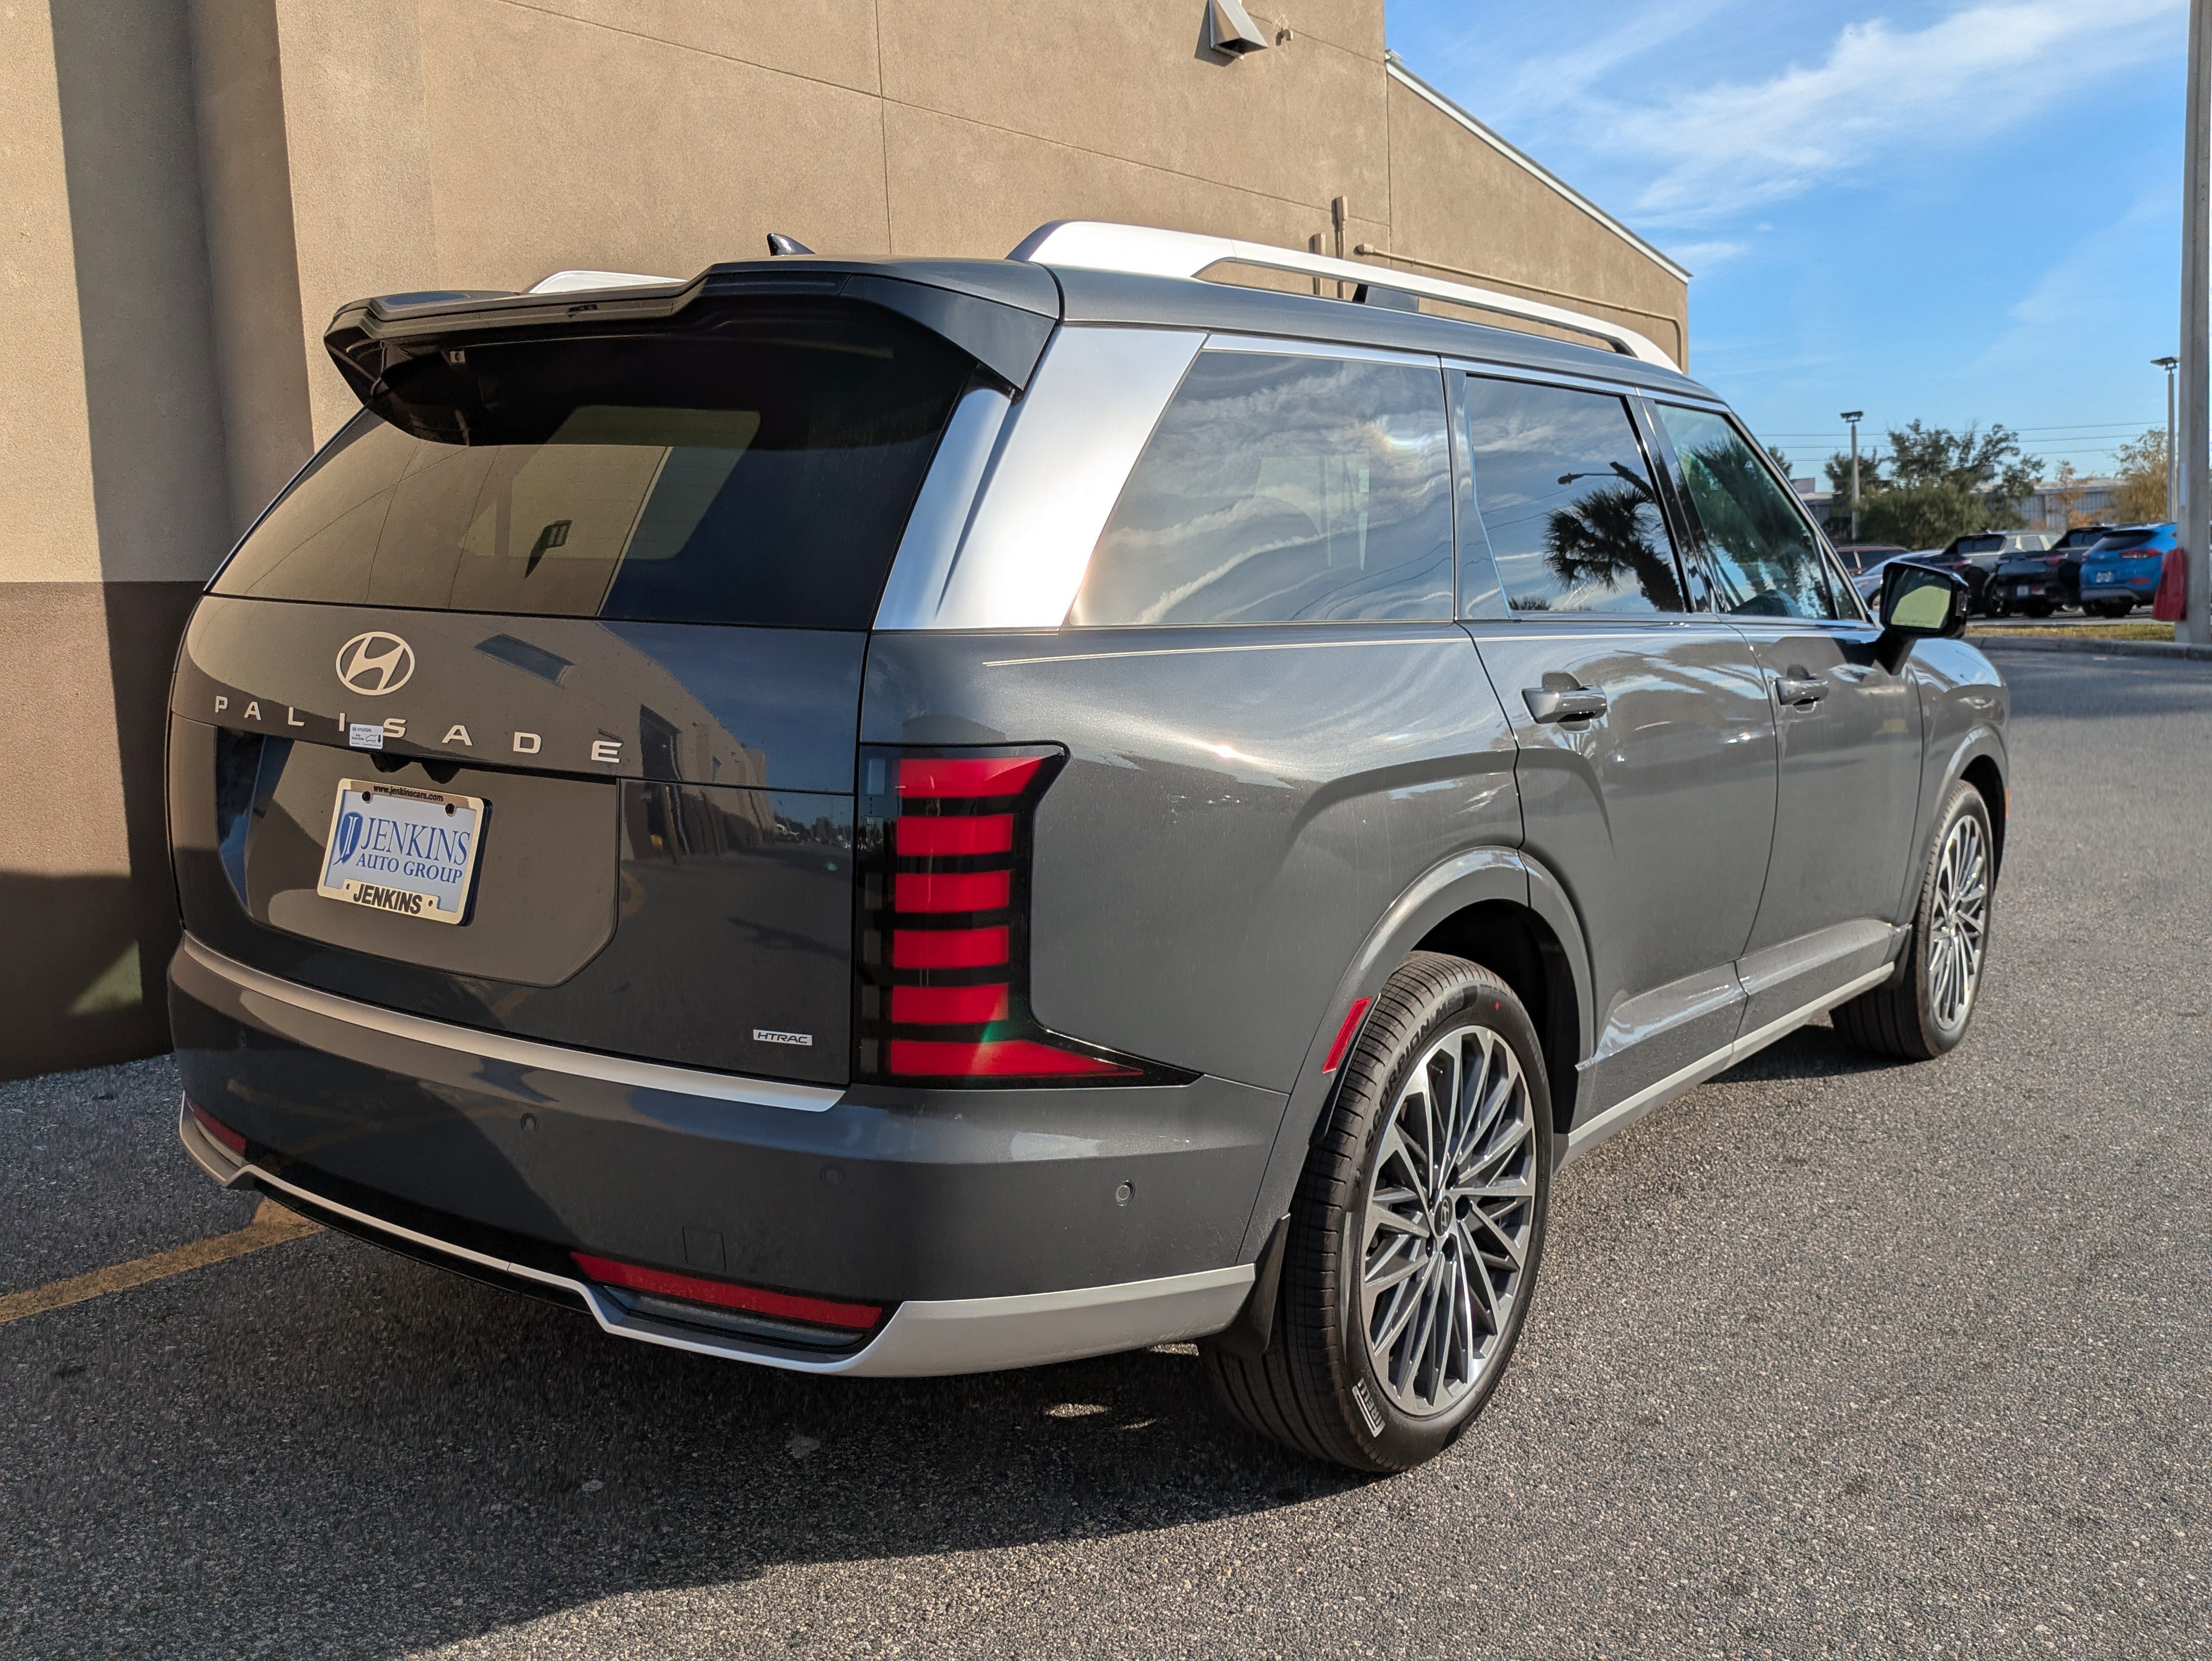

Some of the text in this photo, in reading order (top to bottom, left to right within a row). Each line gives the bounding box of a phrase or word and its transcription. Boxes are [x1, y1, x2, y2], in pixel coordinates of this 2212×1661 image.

[214, 696, 623, 764] PALISADE
[374, 786, 444, 802] www.jenkinscars.com
[361, 817, 470, 865] JENKINS
[355, 853, 463, 884] AUTO GROUP
[353, 884, 422, 914] JENKINS
[758, 1032, 807, 1043] HTRAC
[1365, 1018, 1431, 1153] SCORPION
[1352, 1377, 1385, 1438] PIRELLI
